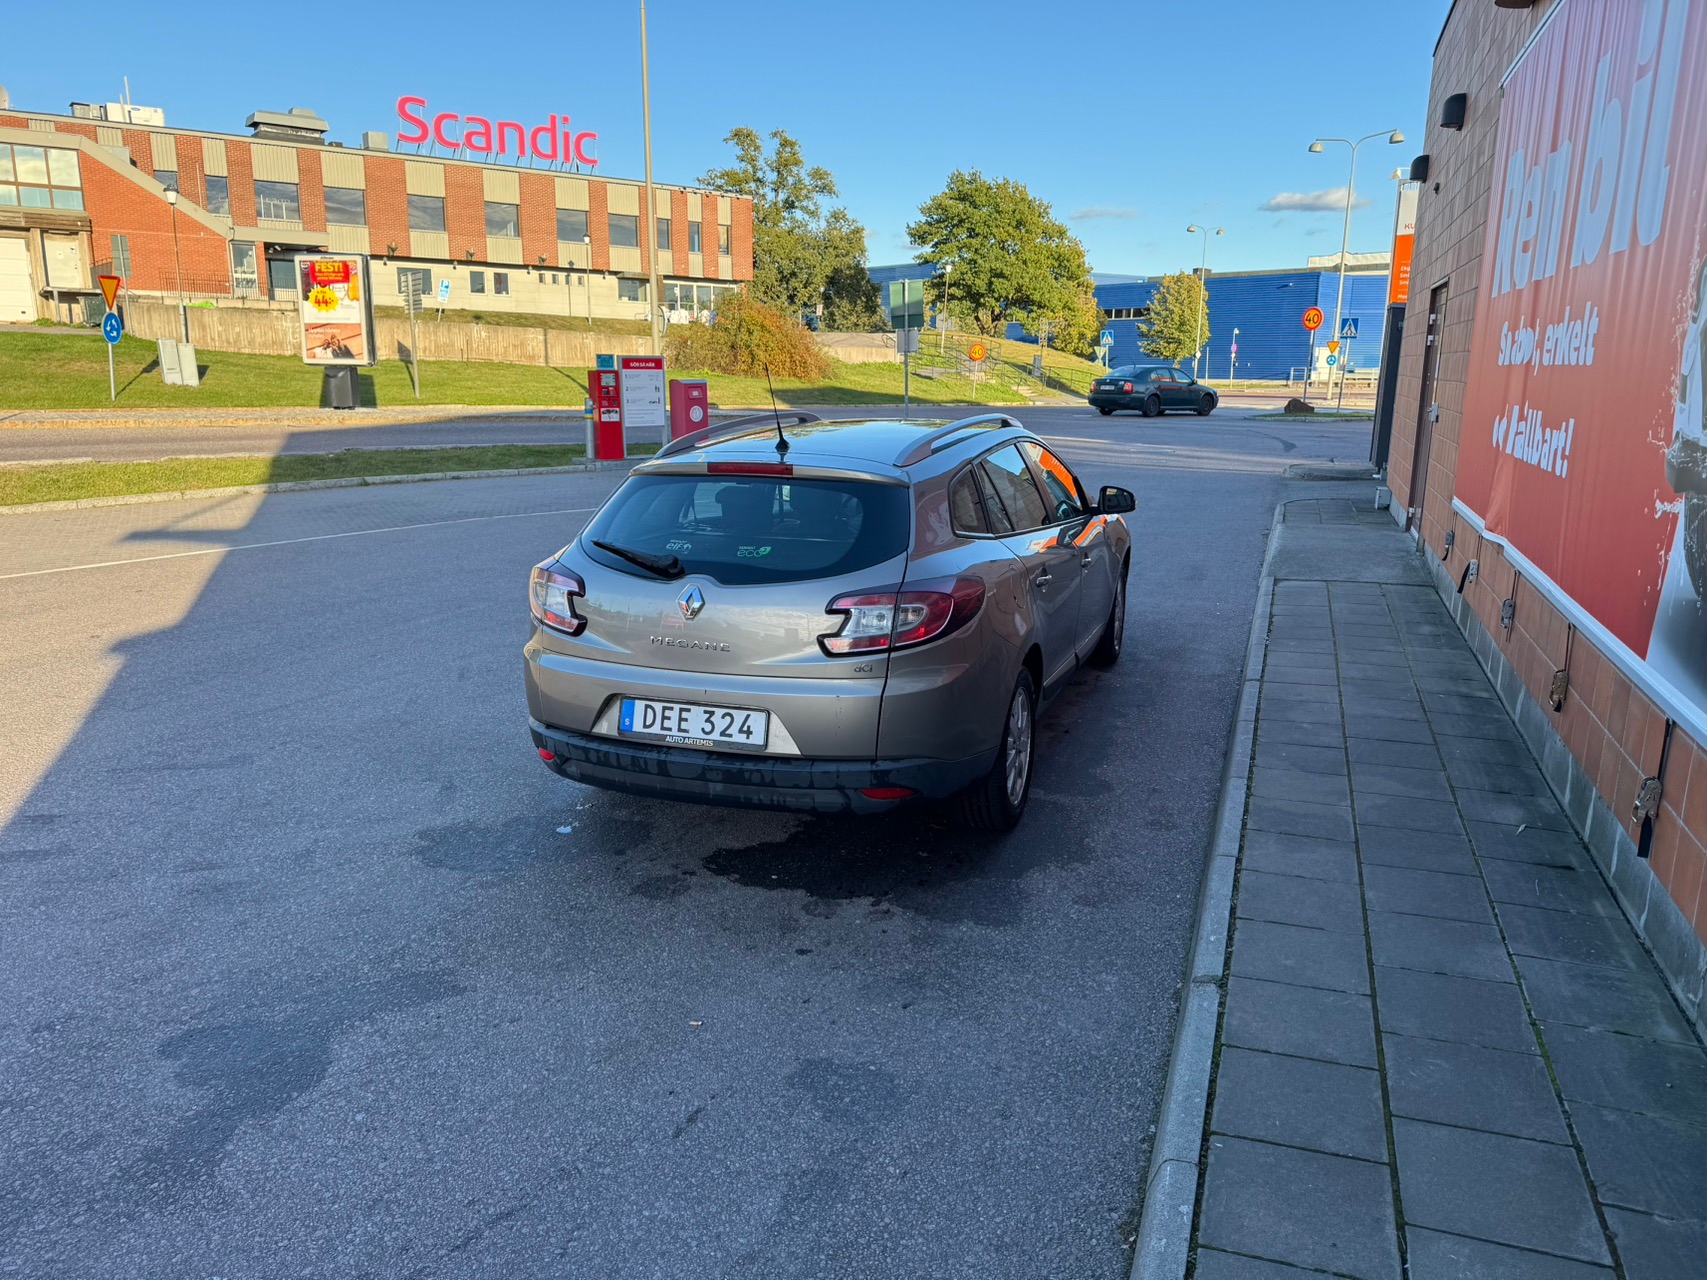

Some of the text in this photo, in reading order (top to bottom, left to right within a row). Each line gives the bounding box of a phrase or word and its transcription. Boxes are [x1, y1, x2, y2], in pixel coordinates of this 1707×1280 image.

[397, 96, 599, 166] Scandic
[1491, 0, 1690, 299] Ren bil
[315, 262, 343, 272] FEST!
[314, 294, 334, 307] 44:-
[1305, 313, 1320, 324] 40
[1542, 301, 1599, 367] enkelt
[972, 347, 983, 356] 40
[650, 635, 731, 652] MEGANE
[853, 663, 873, 672] dCi
[624, 718, 630, 726] S
[642, 703, 754, 740] DEE 324
[665, 735, 714, 747] AUTO ARTEMIS
